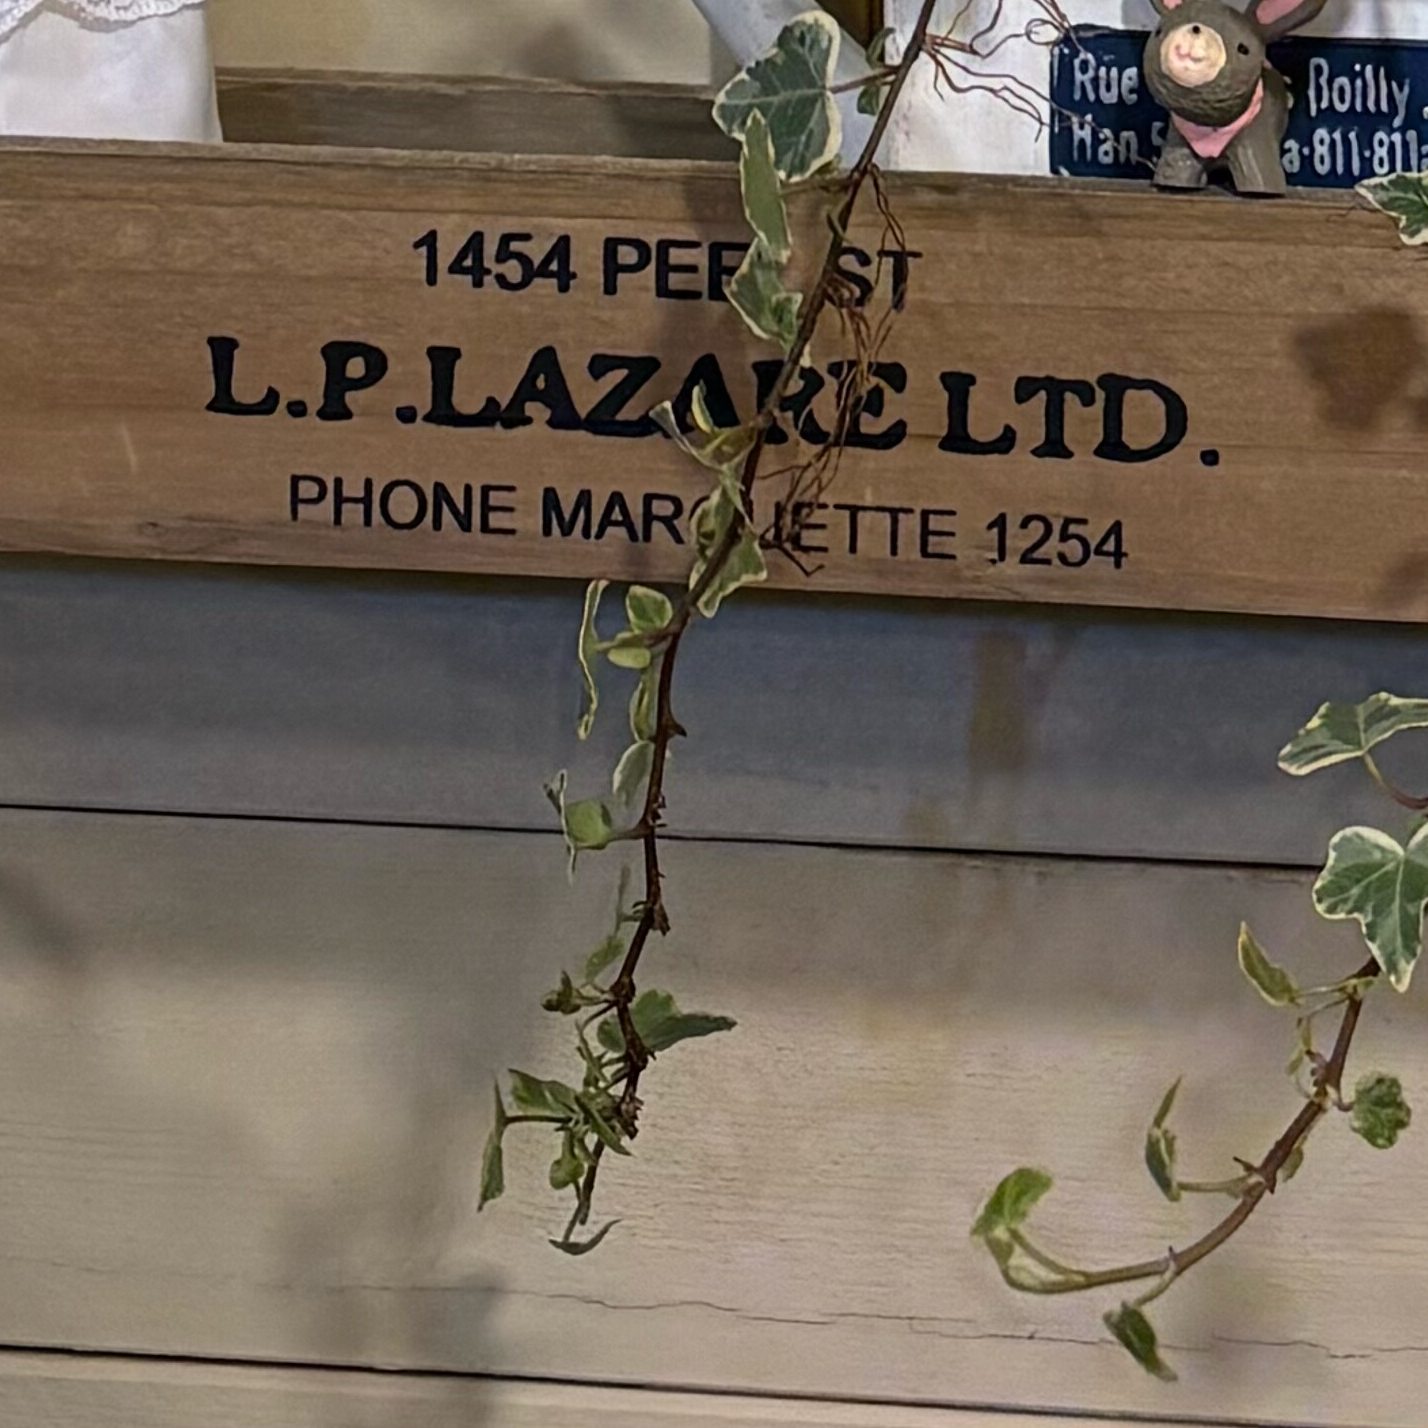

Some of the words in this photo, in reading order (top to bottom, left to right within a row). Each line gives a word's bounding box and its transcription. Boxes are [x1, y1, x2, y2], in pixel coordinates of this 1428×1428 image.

[1073, 52, 1139, 105] Rue
[413, 229, 578, 293] 1454
[829, 246, 923, 312] ST
[938, 371, 1220, 464] LTD.
[290, 474, 517, 536] PHONE
[986, 512, 1129, 570] 1254
